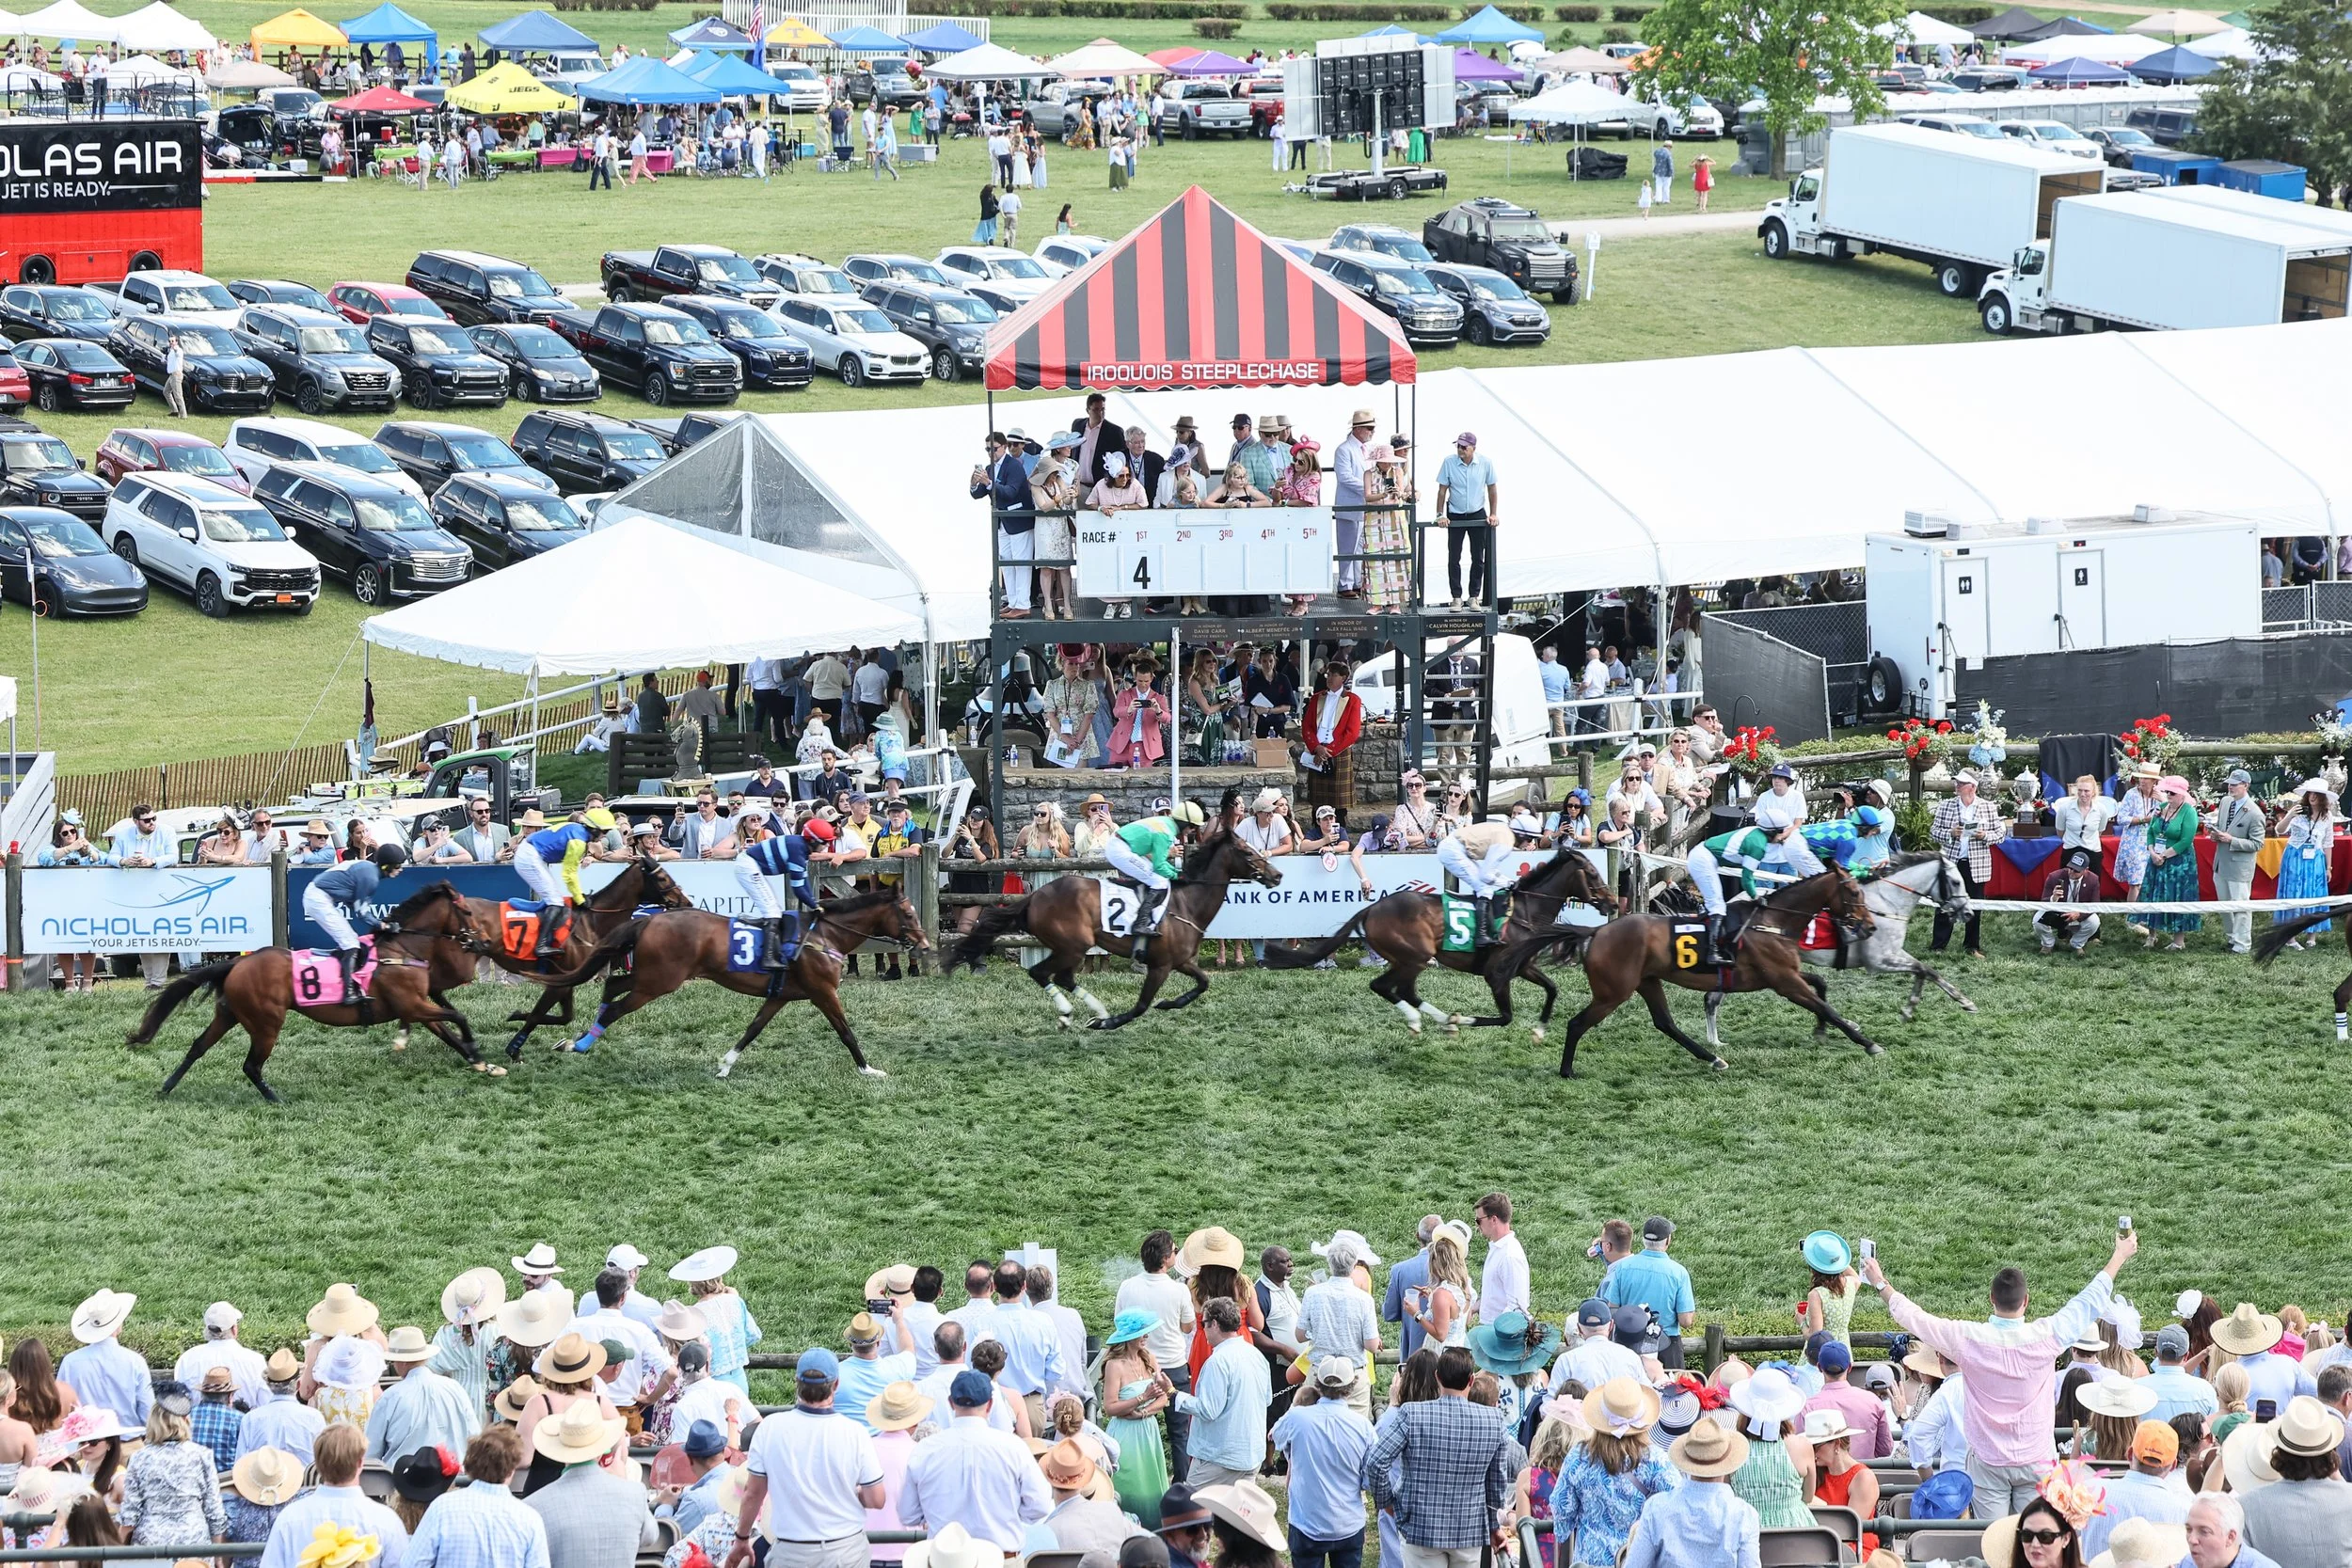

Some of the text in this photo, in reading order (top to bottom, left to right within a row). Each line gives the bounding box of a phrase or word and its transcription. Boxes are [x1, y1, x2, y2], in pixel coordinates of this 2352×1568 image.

[114, 141, 183, 175] AIR
[2, 181, 111, 199] JET IS READY.
[1088, 363, 1319, 382] IROQUOIS STEEPLECHASE
[1082, 528, 1317, 543] RACE # 1ST 2ND 3RD 4TH 5TH
[1133, 556, 1151, 590] 4
[1223, 889, 1390, 904] ANK OF AMERICA
[41, 917, 193, 936] NICHOLAS
[1107, 898, 1126, 931] 2
[1449, 911, 1470, 945] 5
[90, 938, 201, 947] YOUR JET IS READY.
[508, 920, 528, 954] 7
[733, 930, 754, 966] 3
[1804, 918, 1817, 945] 1
[1676, 935, 1698, 969] 6
[300, 966, 322, 1000] 8
